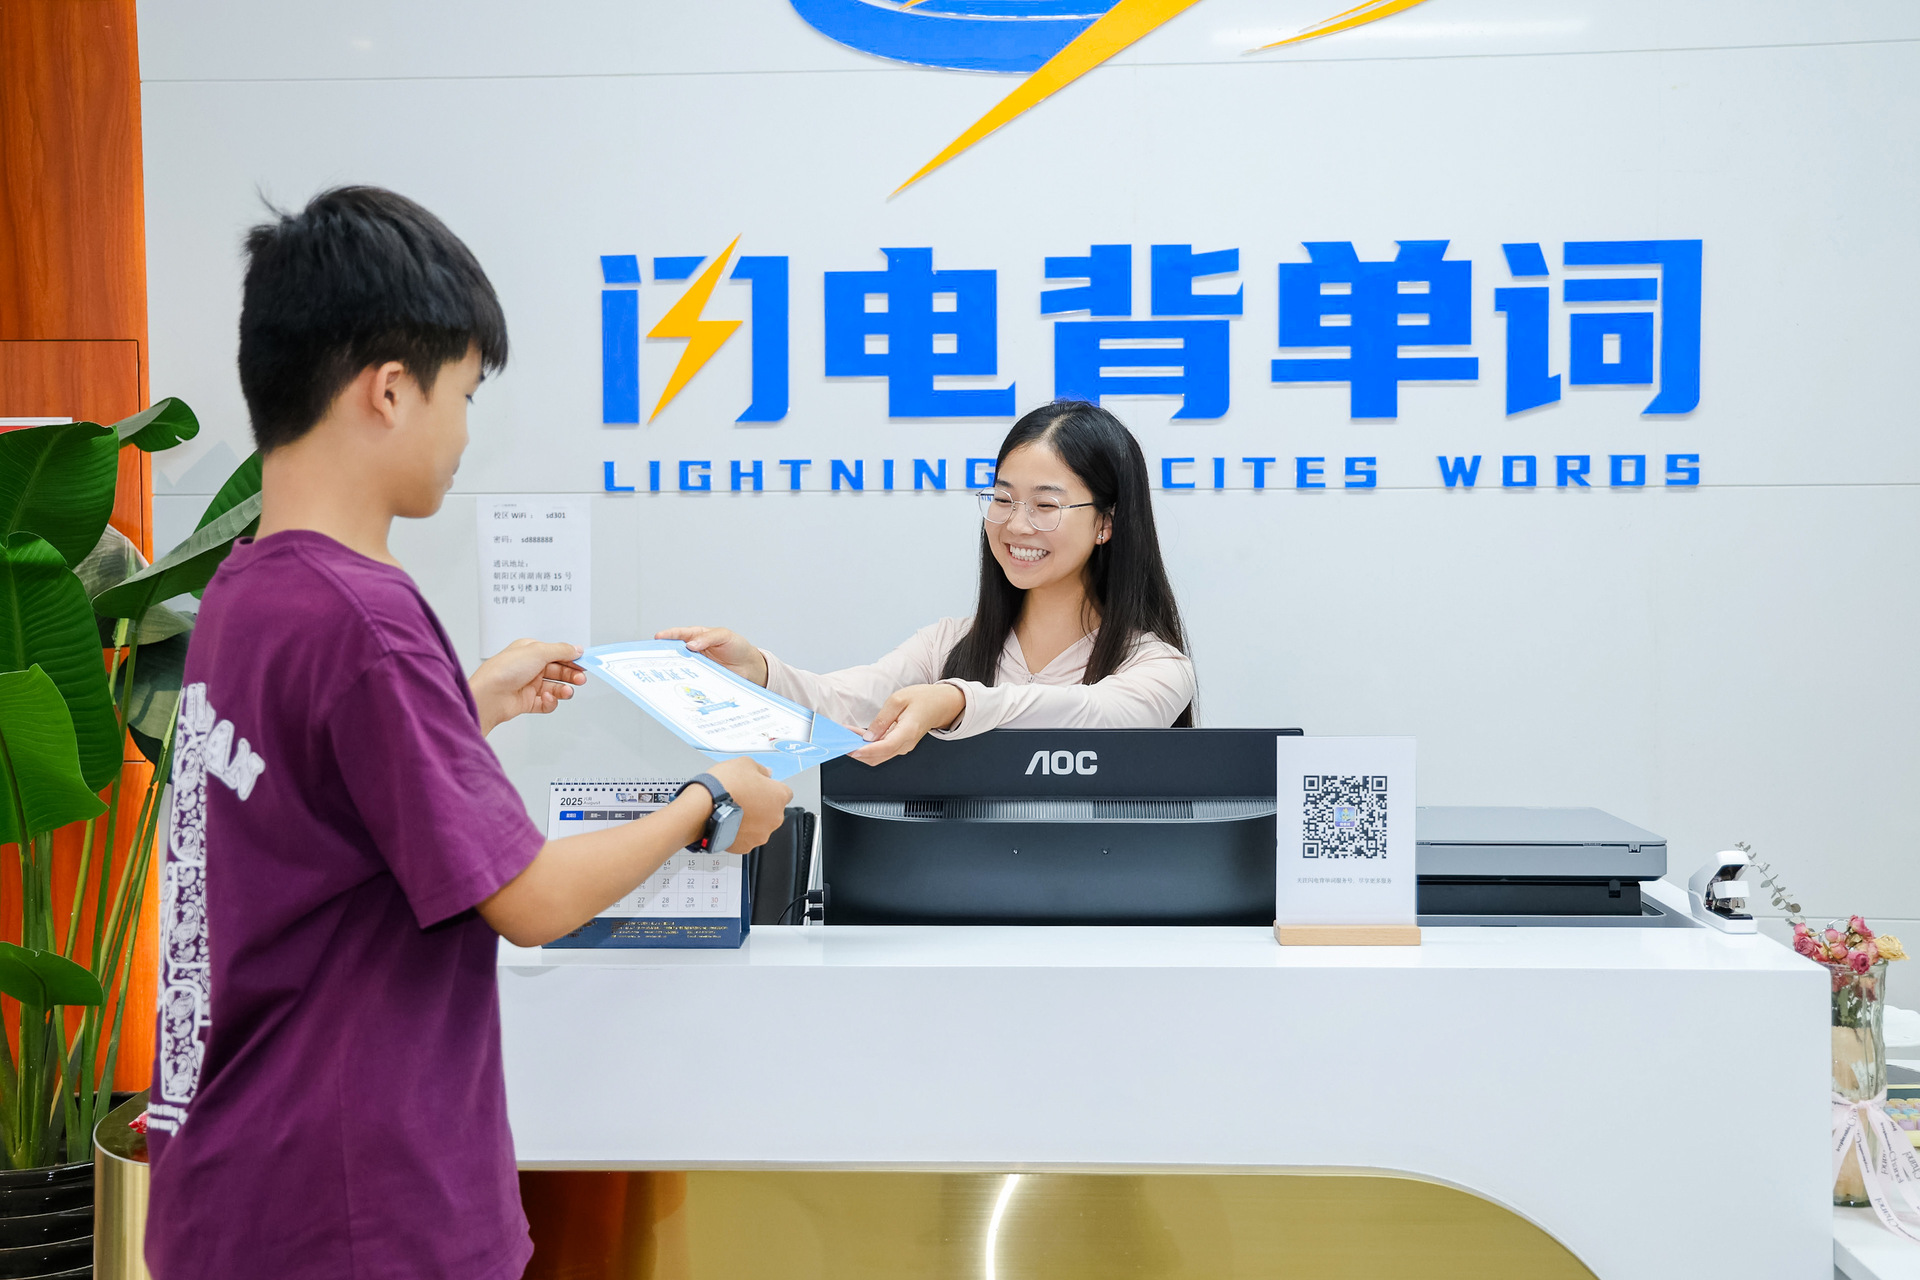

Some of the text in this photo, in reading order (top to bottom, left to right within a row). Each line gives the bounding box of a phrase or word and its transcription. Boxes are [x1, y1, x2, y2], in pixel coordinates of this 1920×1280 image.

[600, 232, 1703, 426] 闪电背单词
[604, 454, 1700, 491] LIGHTNING CITES WORDS
[1025, 750, 1098, 776] AOC
[560, 797, 583, 806] 2025
